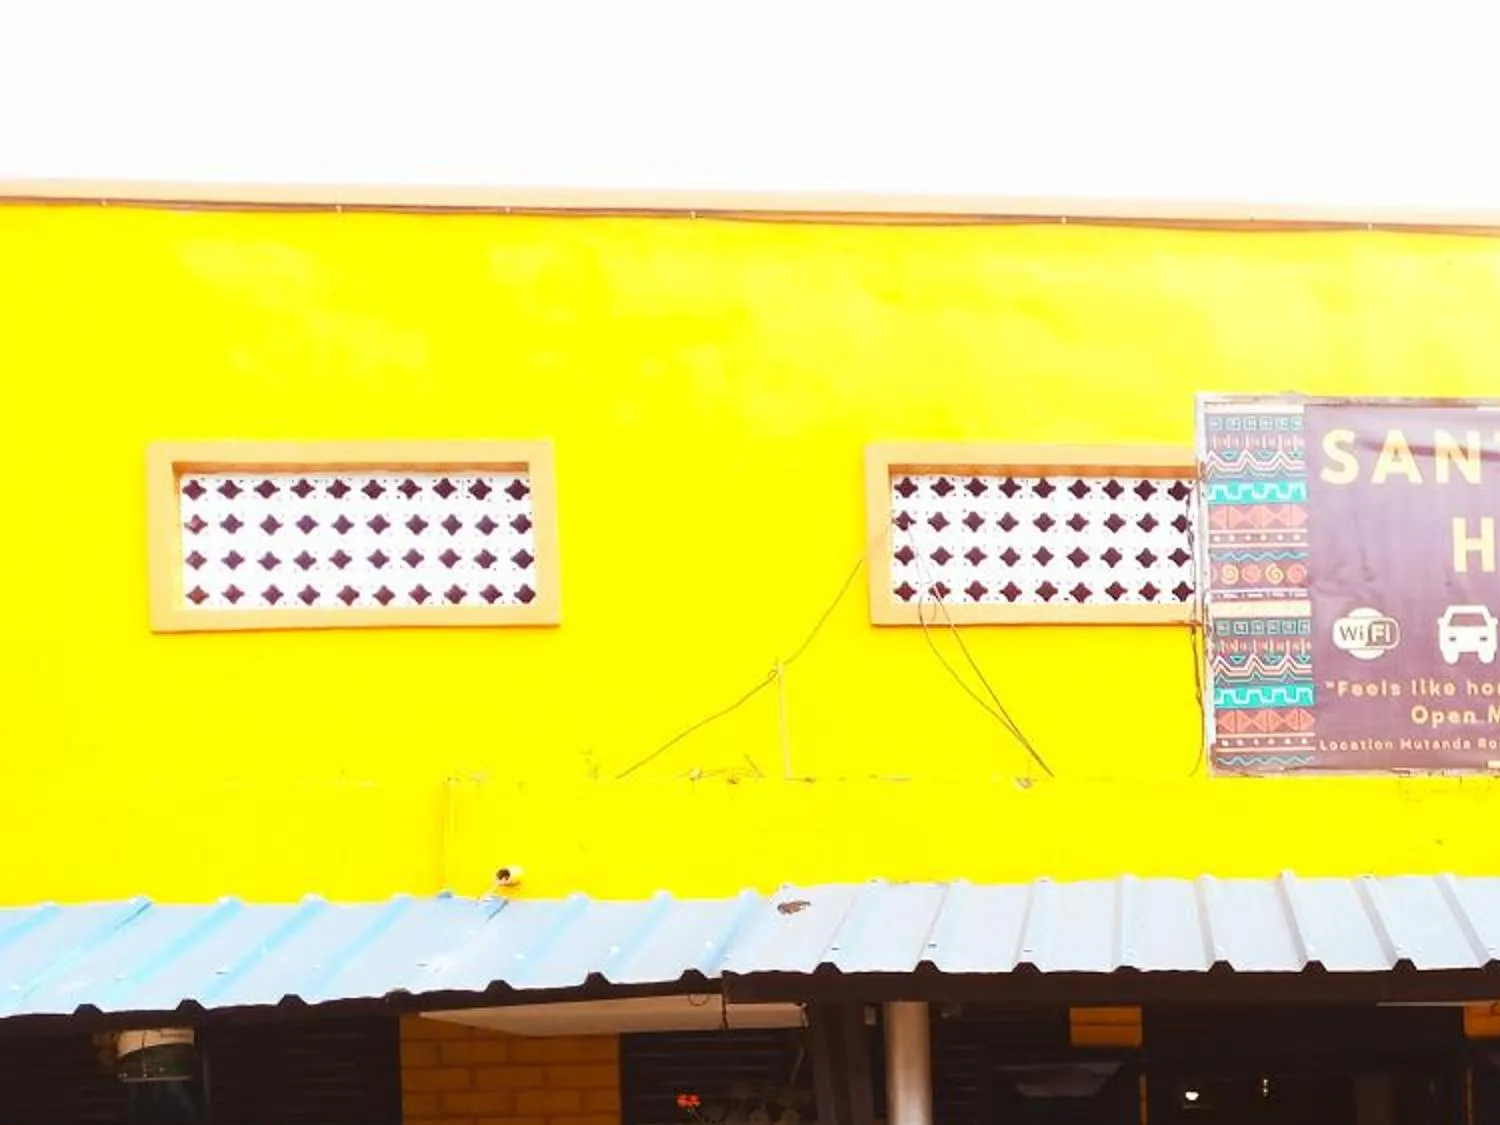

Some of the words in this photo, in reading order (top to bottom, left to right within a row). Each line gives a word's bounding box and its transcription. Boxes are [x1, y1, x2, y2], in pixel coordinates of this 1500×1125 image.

[1411, 678, 1456, 696] like
[1411, 704, 1477, 728] Open
[1319, 738, 1394, 751] Location
[1400, 736, 1472, 750] Mutanda
